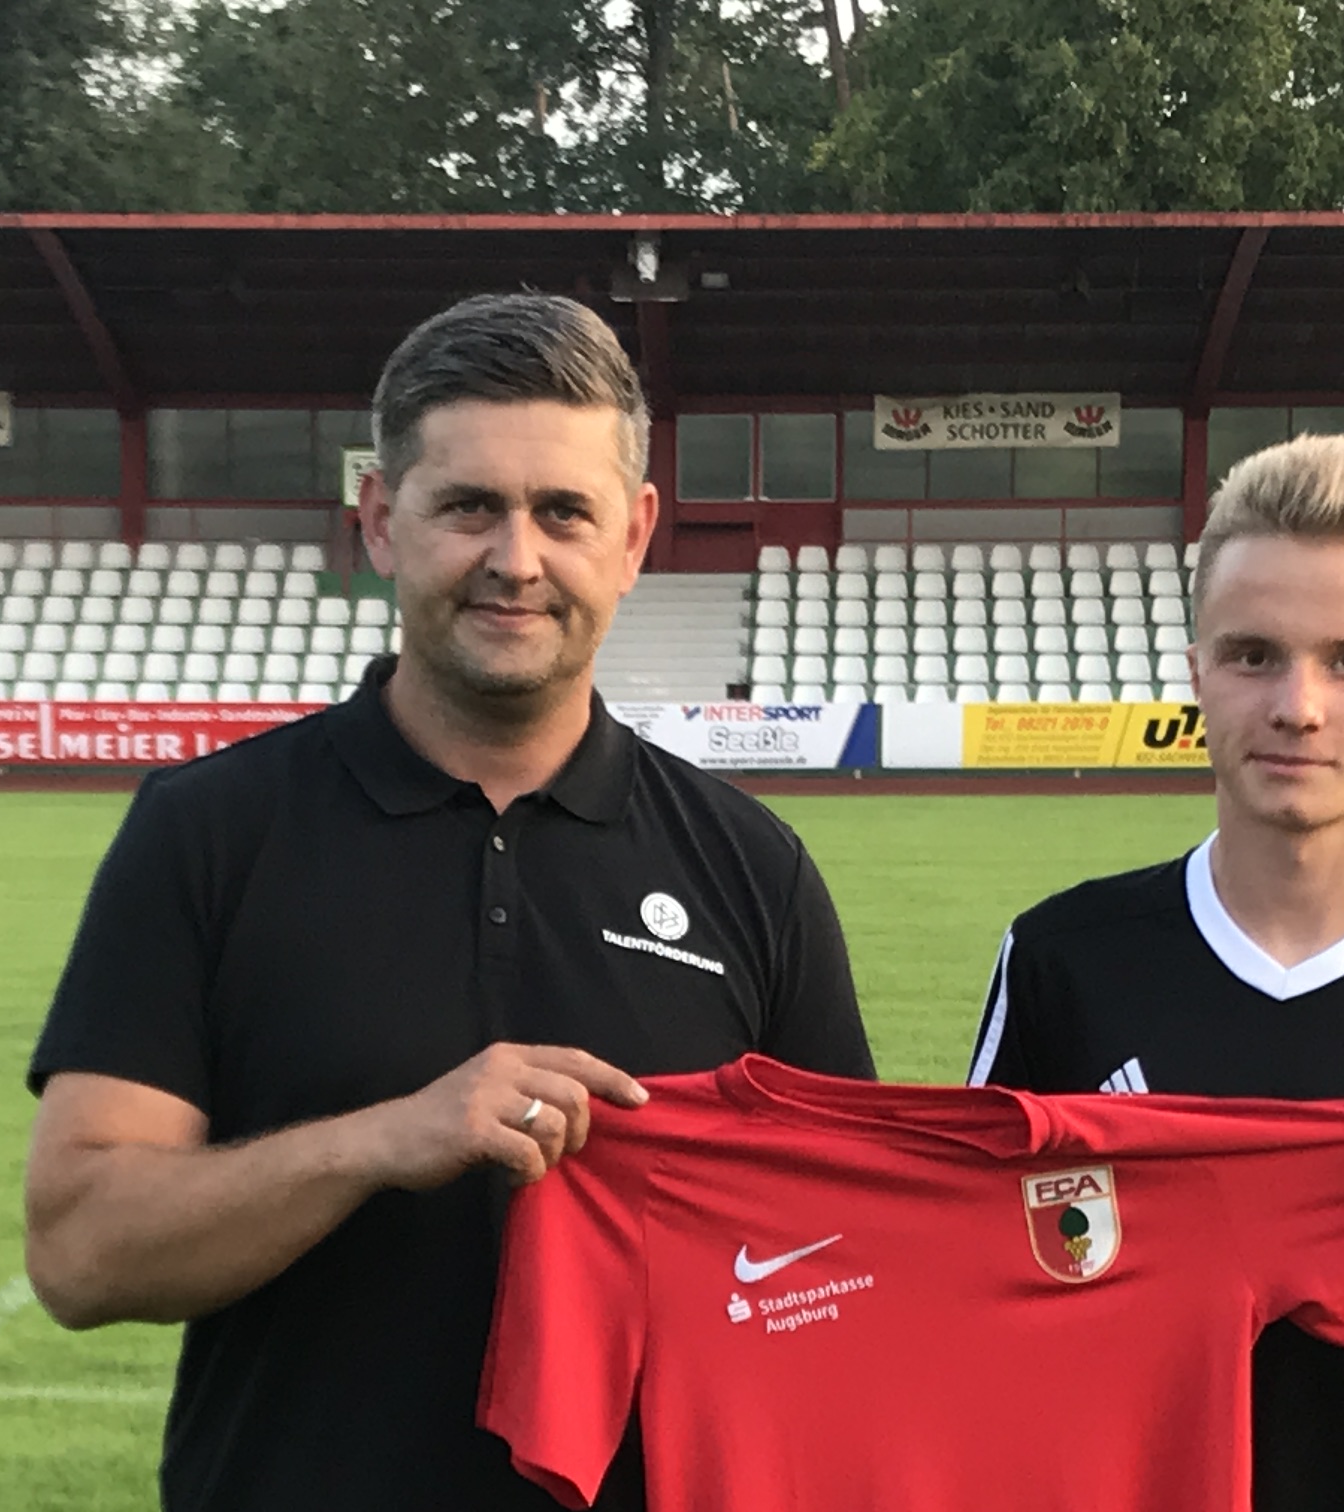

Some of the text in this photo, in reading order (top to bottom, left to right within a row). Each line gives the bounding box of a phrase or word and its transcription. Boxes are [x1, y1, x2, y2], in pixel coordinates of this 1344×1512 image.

[942, 400, 1055, 419] KIES SAND
[946, 421, 1046, 441] SCHOTTER
[704, 705, 822, 722] INTERSPORT
[601, 929, 725, 975] TALENTFÖRDERUNG
[1035, 1174, 1102, 1203] FCA
[758, 1274, 874, 1315] Stadtsparkasse
[766, 1303, 839, 1334] Augsburg
